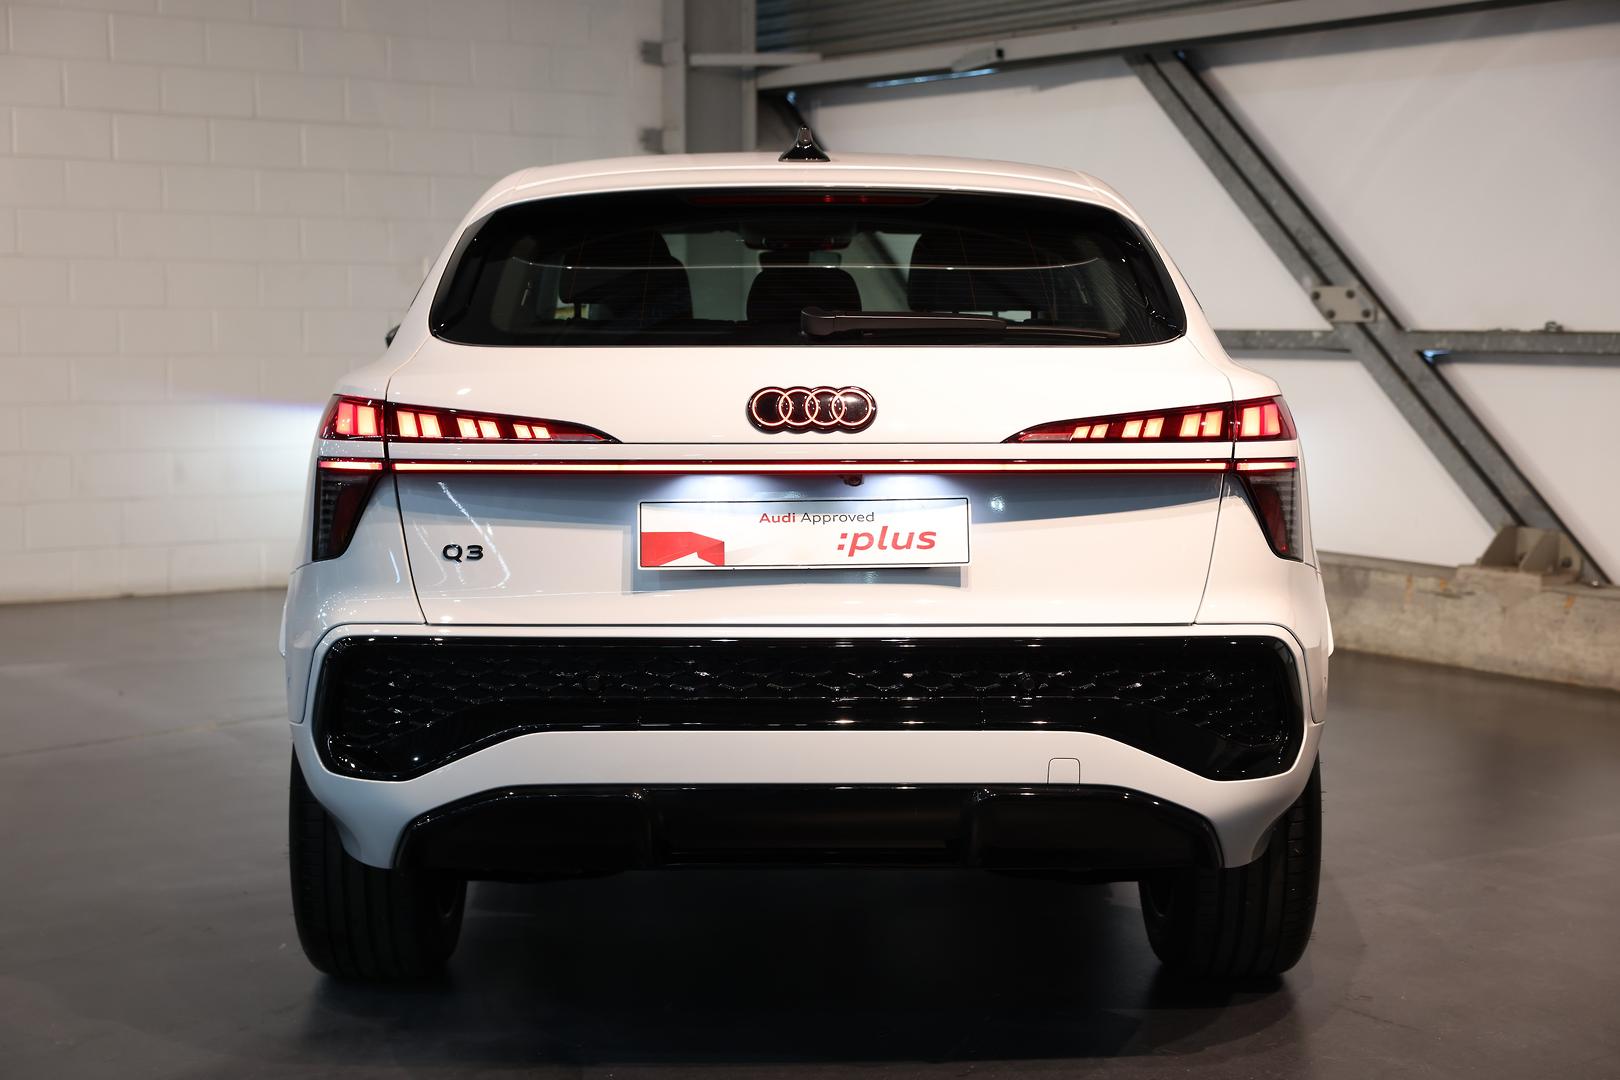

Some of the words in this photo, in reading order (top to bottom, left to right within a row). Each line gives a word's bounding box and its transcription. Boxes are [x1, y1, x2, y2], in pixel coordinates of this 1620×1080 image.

[759, 512, 796, 523] Audi
[800, 511, 875, 525] Approved
[837, 525, 937, 557] :plus
[443, 544, 483, 562] Q3
